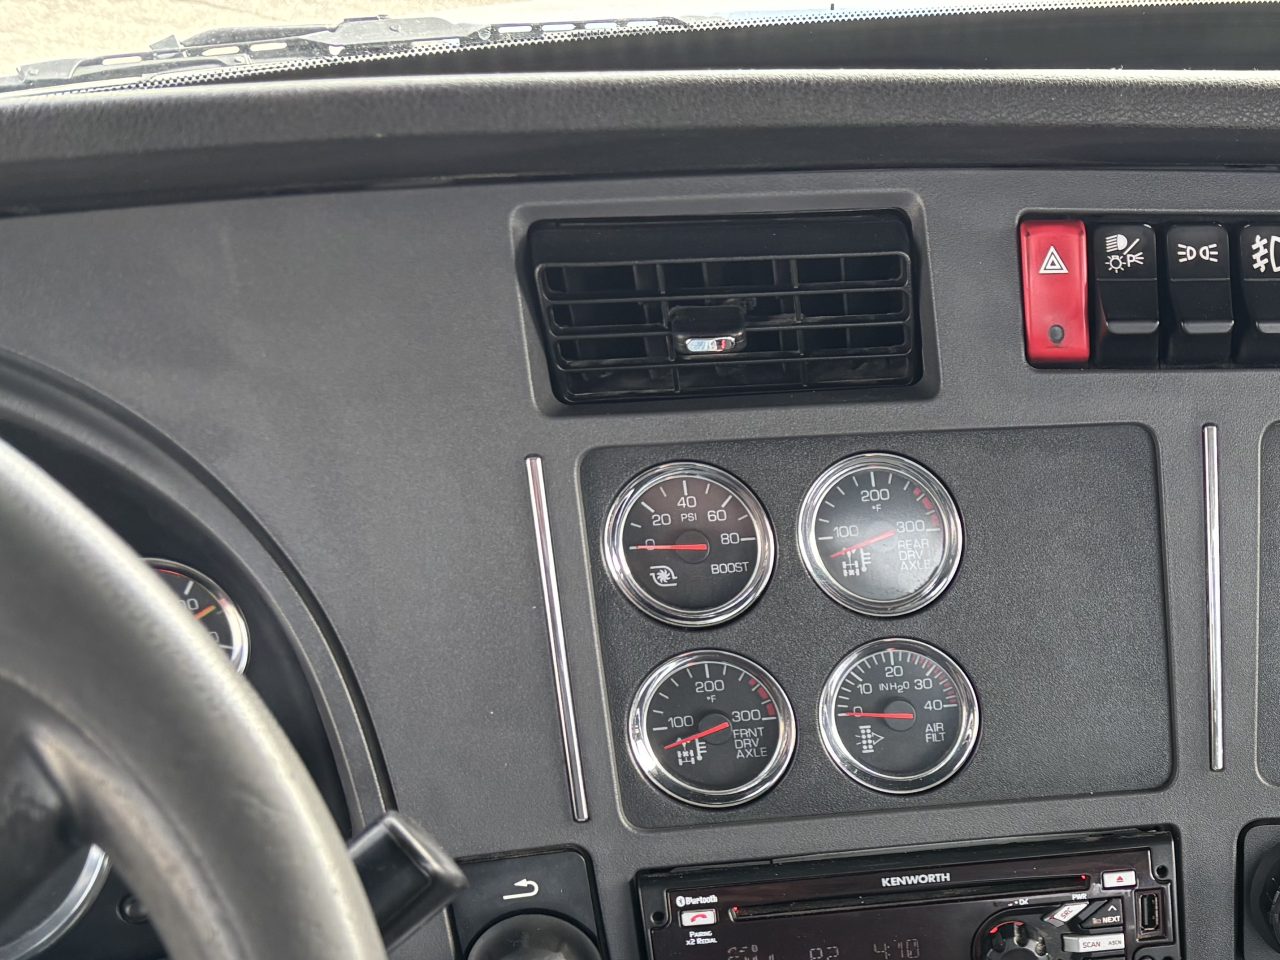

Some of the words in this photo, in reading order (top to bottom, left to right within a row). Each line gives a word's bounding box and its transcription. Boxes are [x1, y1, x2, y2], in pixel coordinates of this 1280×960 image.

[860, 488, 890, 501] 200
[677, 496, 697, 509] 40
[651, 514, 671, 527] 20
[681, 513, 698, 522] PSI
[707, 510, 727, 522] 60
[834, 525, 859, 538] 100
[896, 520, 925, 533] 300
[720, 533, 740, 545] 80
[897, 539, 929, 550] REAR
[900, 550, 923, 561] DRV
[711, 561, 750, 574] BOOST
[901, 559, 931, 571] AXLE
[885, 666, 903, 677] 20
[695, 679, 725, 692] 200
[857, 683, 872, 694] 10
[914, 678, 933, 689] 30
[924, 699, 943, 711] 40
[668, 715, 694, 728] 100
[732, 709, 761, 722] 300
[733, 726, 764, 739] FRNT
[925, 723, 944, 733] AIR
[734, 736, 760, 748] DRV
[925, 732, 946, 743] FILT
[735, 746, 768, 759] AXLE
[881, 873, 950, 887] KENWORTH
[1060, 907, 1073, 919] SRC
[1102, 915, 1121, 924] NEXT
